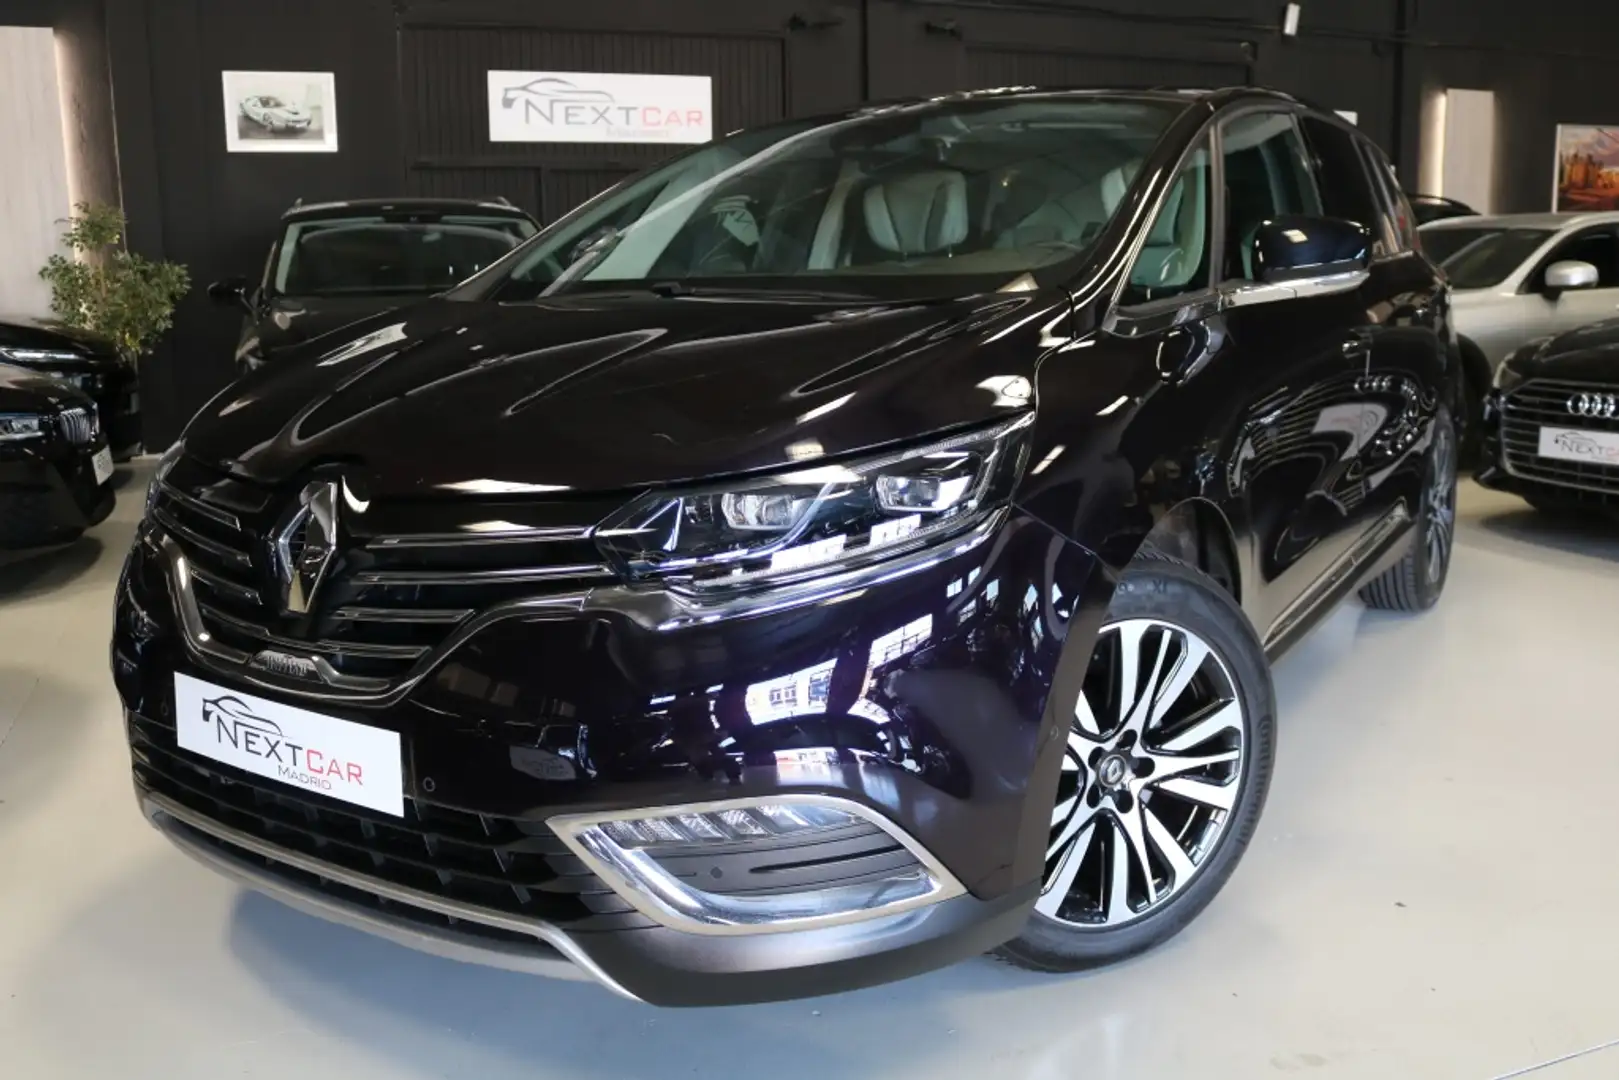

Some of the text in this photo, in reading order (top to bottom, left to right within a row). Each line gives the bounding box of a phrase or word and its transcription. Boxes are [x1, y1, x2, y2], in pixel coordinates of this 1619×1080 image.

[524, 98, 704, 127] NEXTCAR
[1560, 440, 1619, 456] NEXTC
[216, 714, 364, 786] NEXTCAR
[277, 764, 332, 791] MADRID
